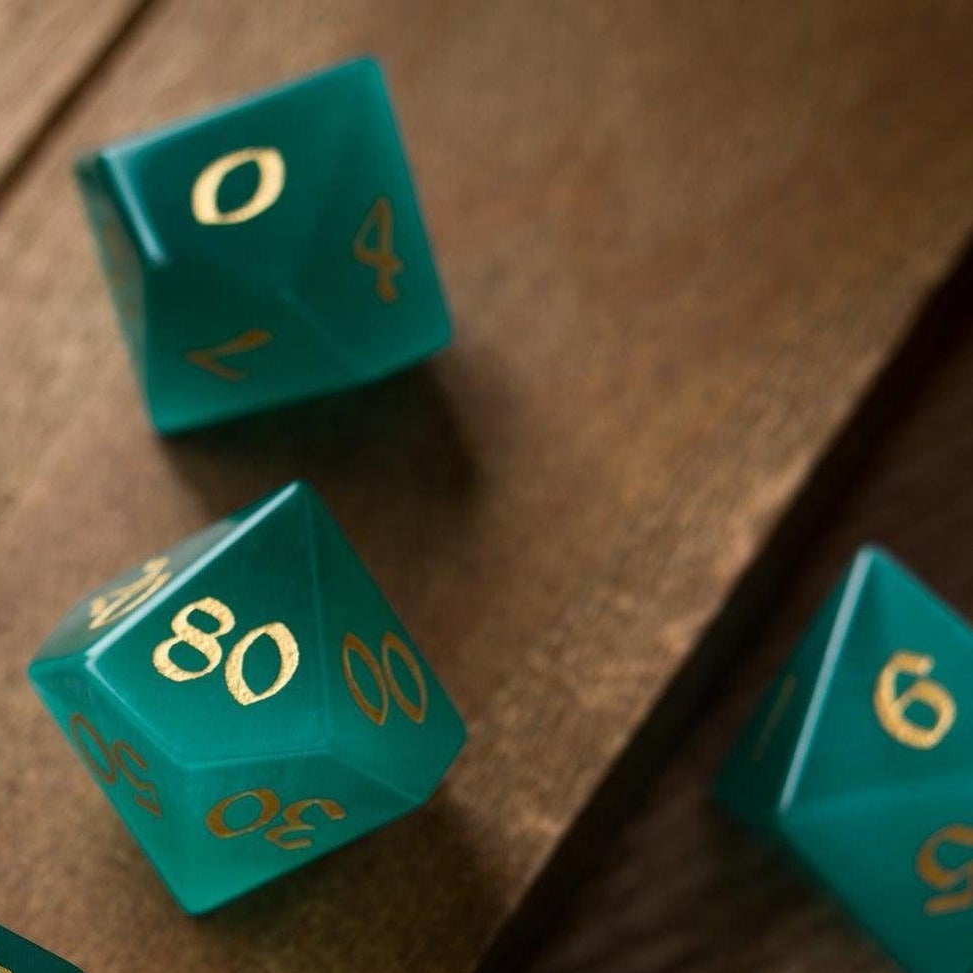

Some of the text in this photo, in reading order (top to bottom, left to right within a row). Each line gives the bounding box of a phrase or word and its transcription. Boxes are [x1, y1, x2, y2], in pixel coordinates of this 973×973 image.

[191, 147, 286, 226] 0
[353, 197, 404, 304] 4
[153, 597, 299, 706] 80
[343, 632, 427, 725] 00
[873, 650, 957, 750] 6
[206, 788, 346, 850] 30
